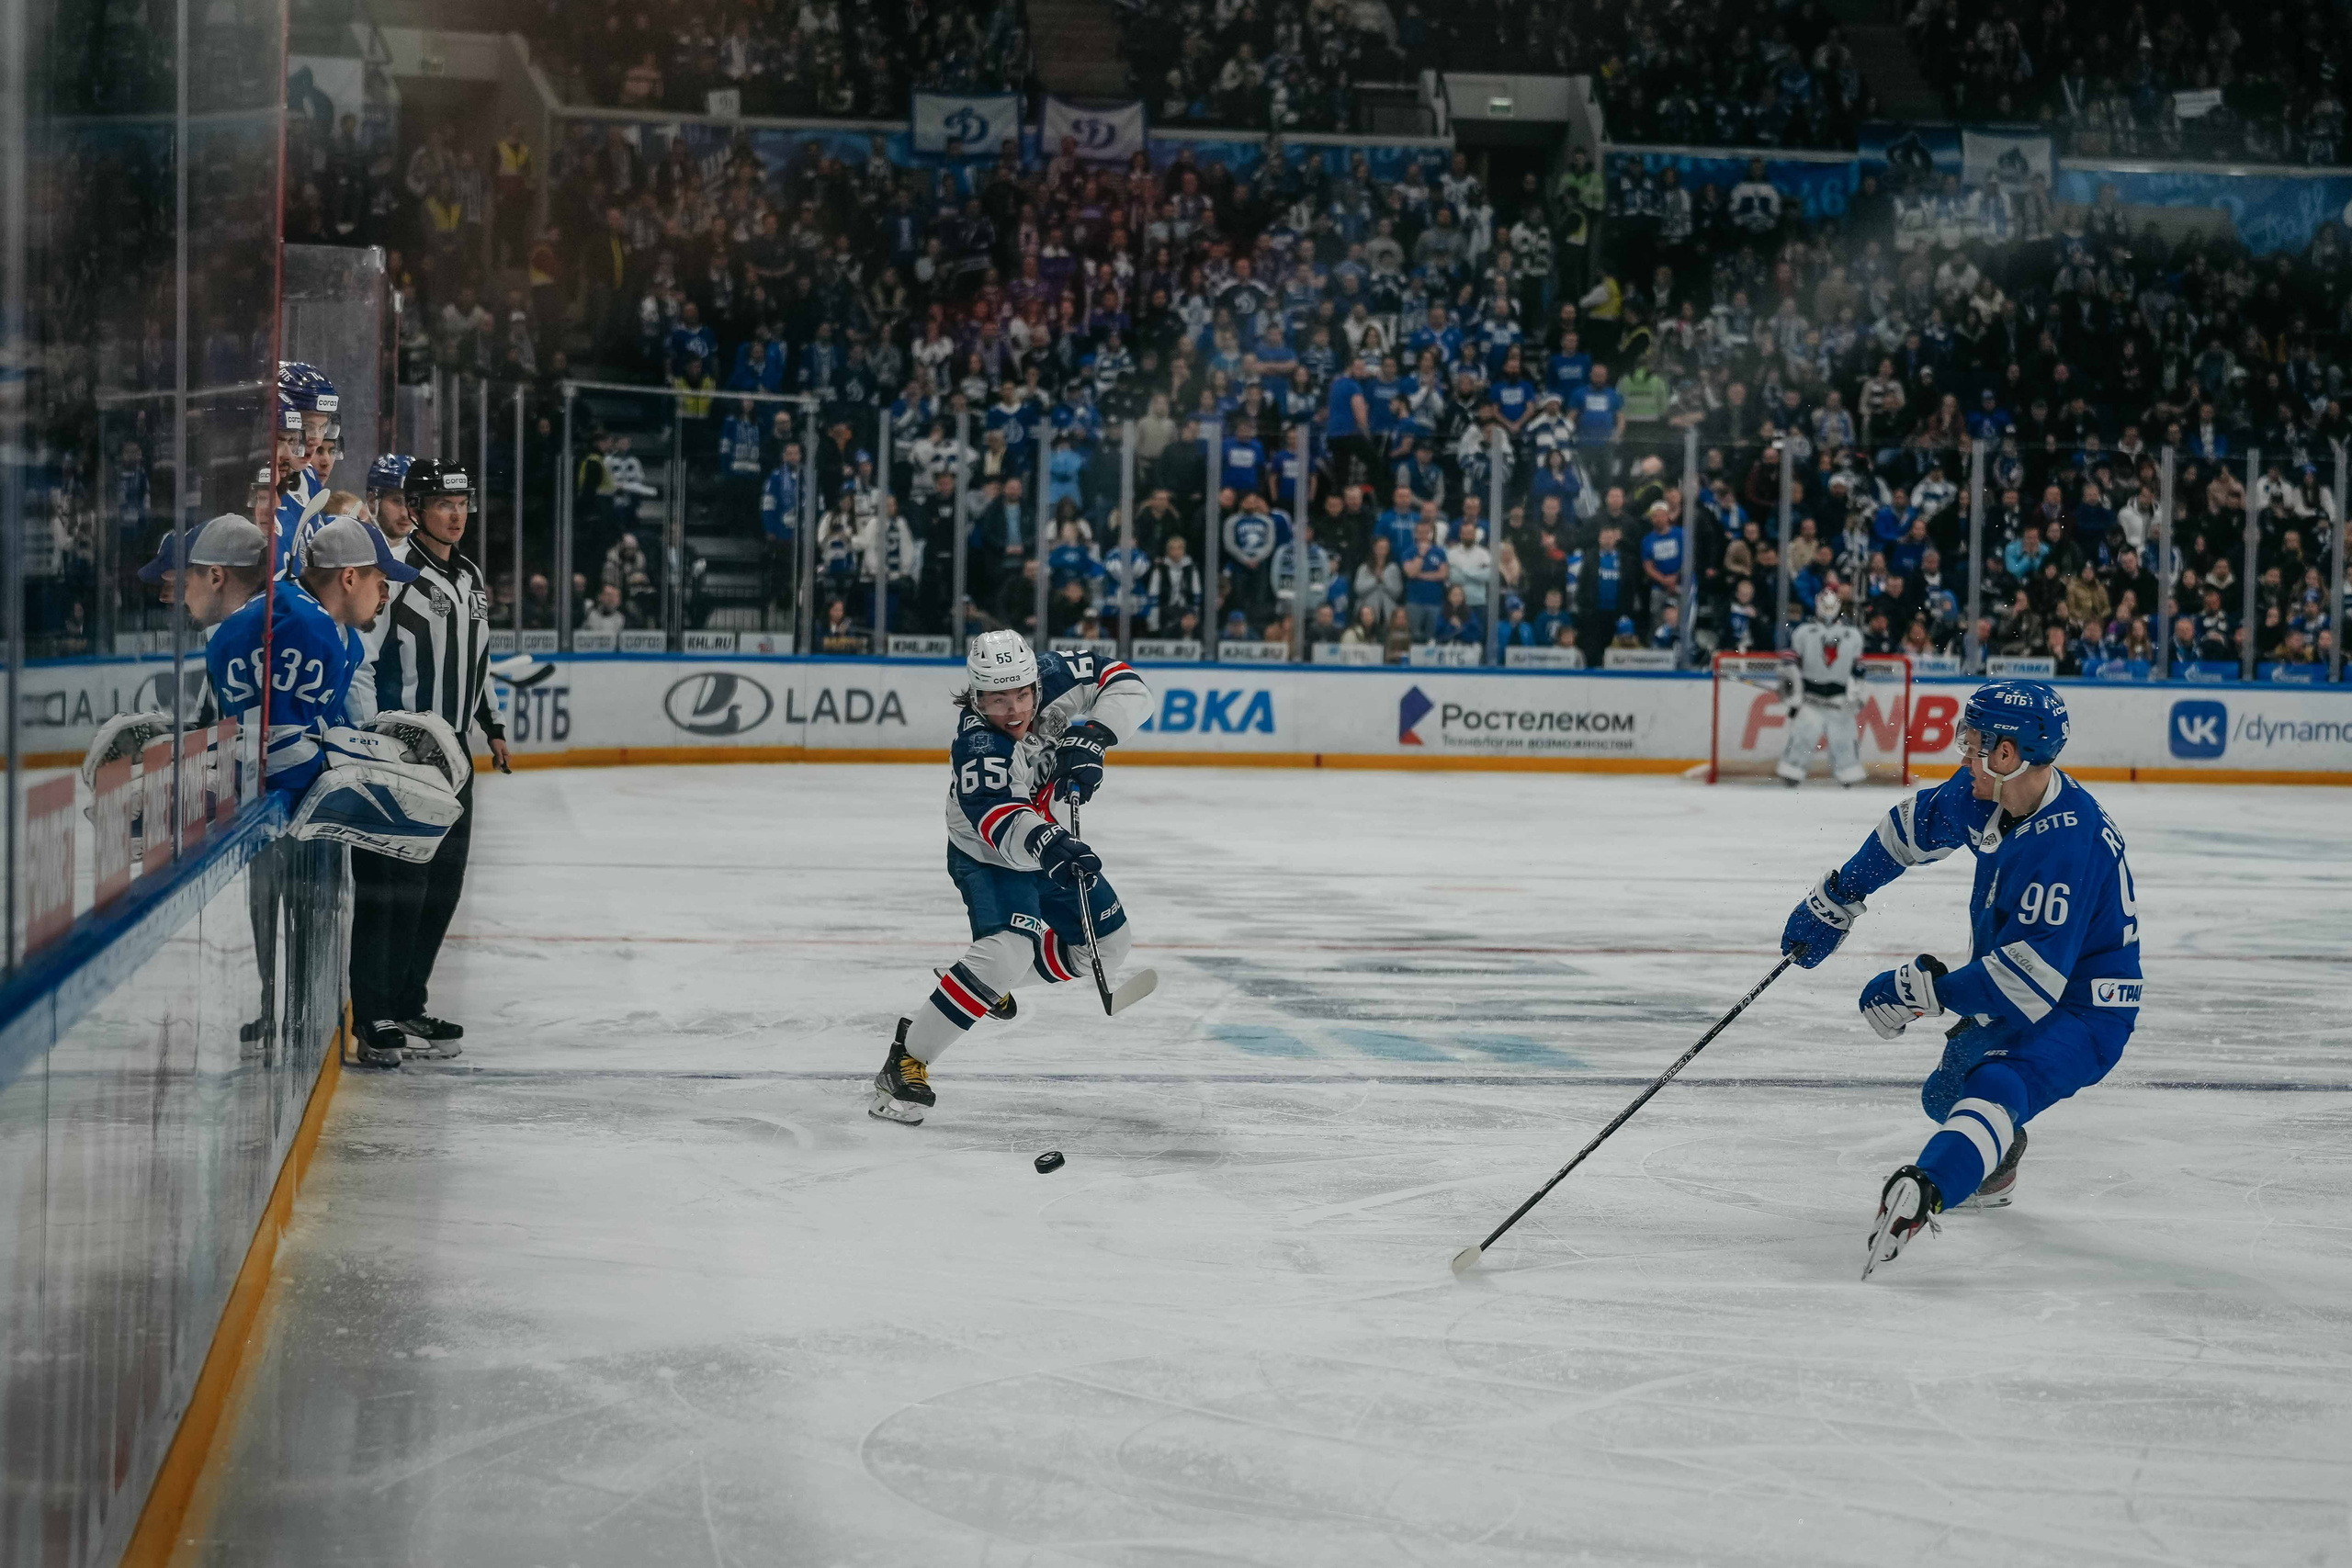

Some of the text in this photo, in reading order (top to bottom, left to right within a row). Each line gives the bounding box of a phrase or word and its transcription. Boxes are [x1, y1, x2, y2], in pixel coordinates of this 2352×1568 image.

[996, 651, 1012, 664] 65
[272, 648, 324, 705] 32
[993, 674, 1021, 684] согаз
[514, 686, 571, 743] ВТБ
[786, 688, 907, 726] LADA
[1140, 690, 1275, 733] ВКА
[2004, 694, 2028, 706] ВТБ
[1442, 703, 1634, 733] Ростелеком
[1993, 723, 2019, 731] CCM
[961, 757, 1009, 795] 65
[2035, 811, 2078, 835] ВТБ
[2018, 882, 2071, 926] 96
